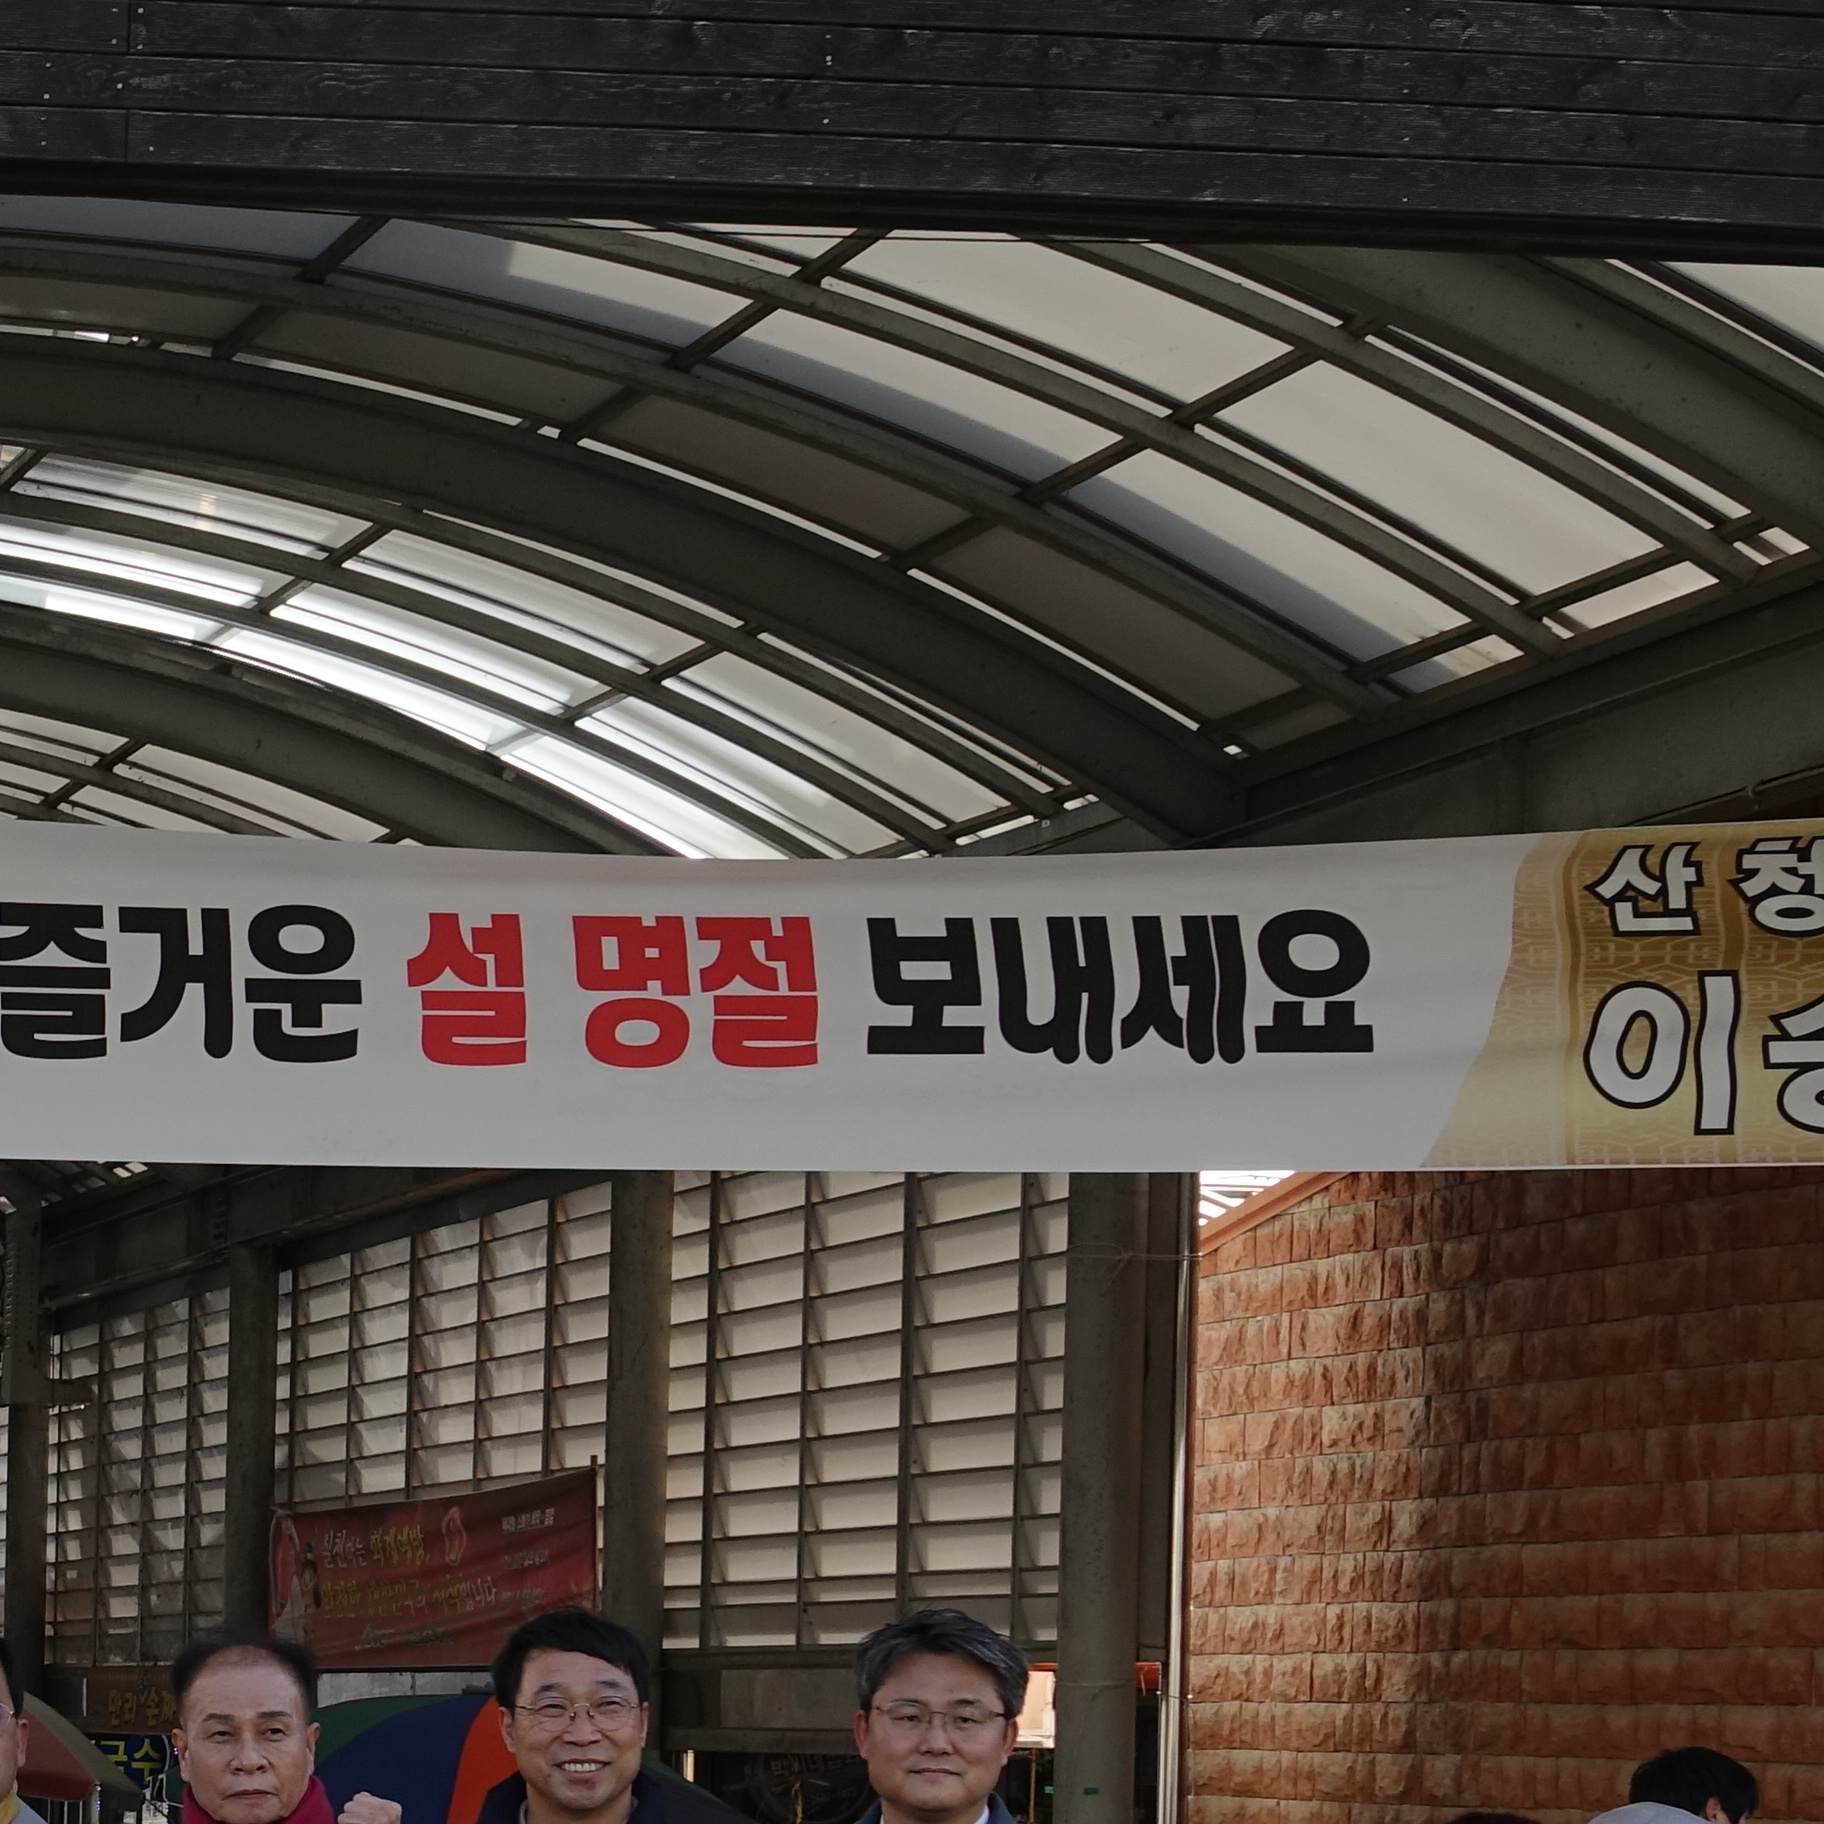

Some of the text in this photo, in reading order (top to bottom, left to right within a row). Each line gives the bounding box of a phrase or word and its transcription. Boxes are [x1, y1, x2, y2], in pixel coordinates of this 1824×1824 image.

[405, 911, 528, 1065] 설
[570, 911, 822, 1068] 명절
[866, 908, 1374, 1065] 보내세요
